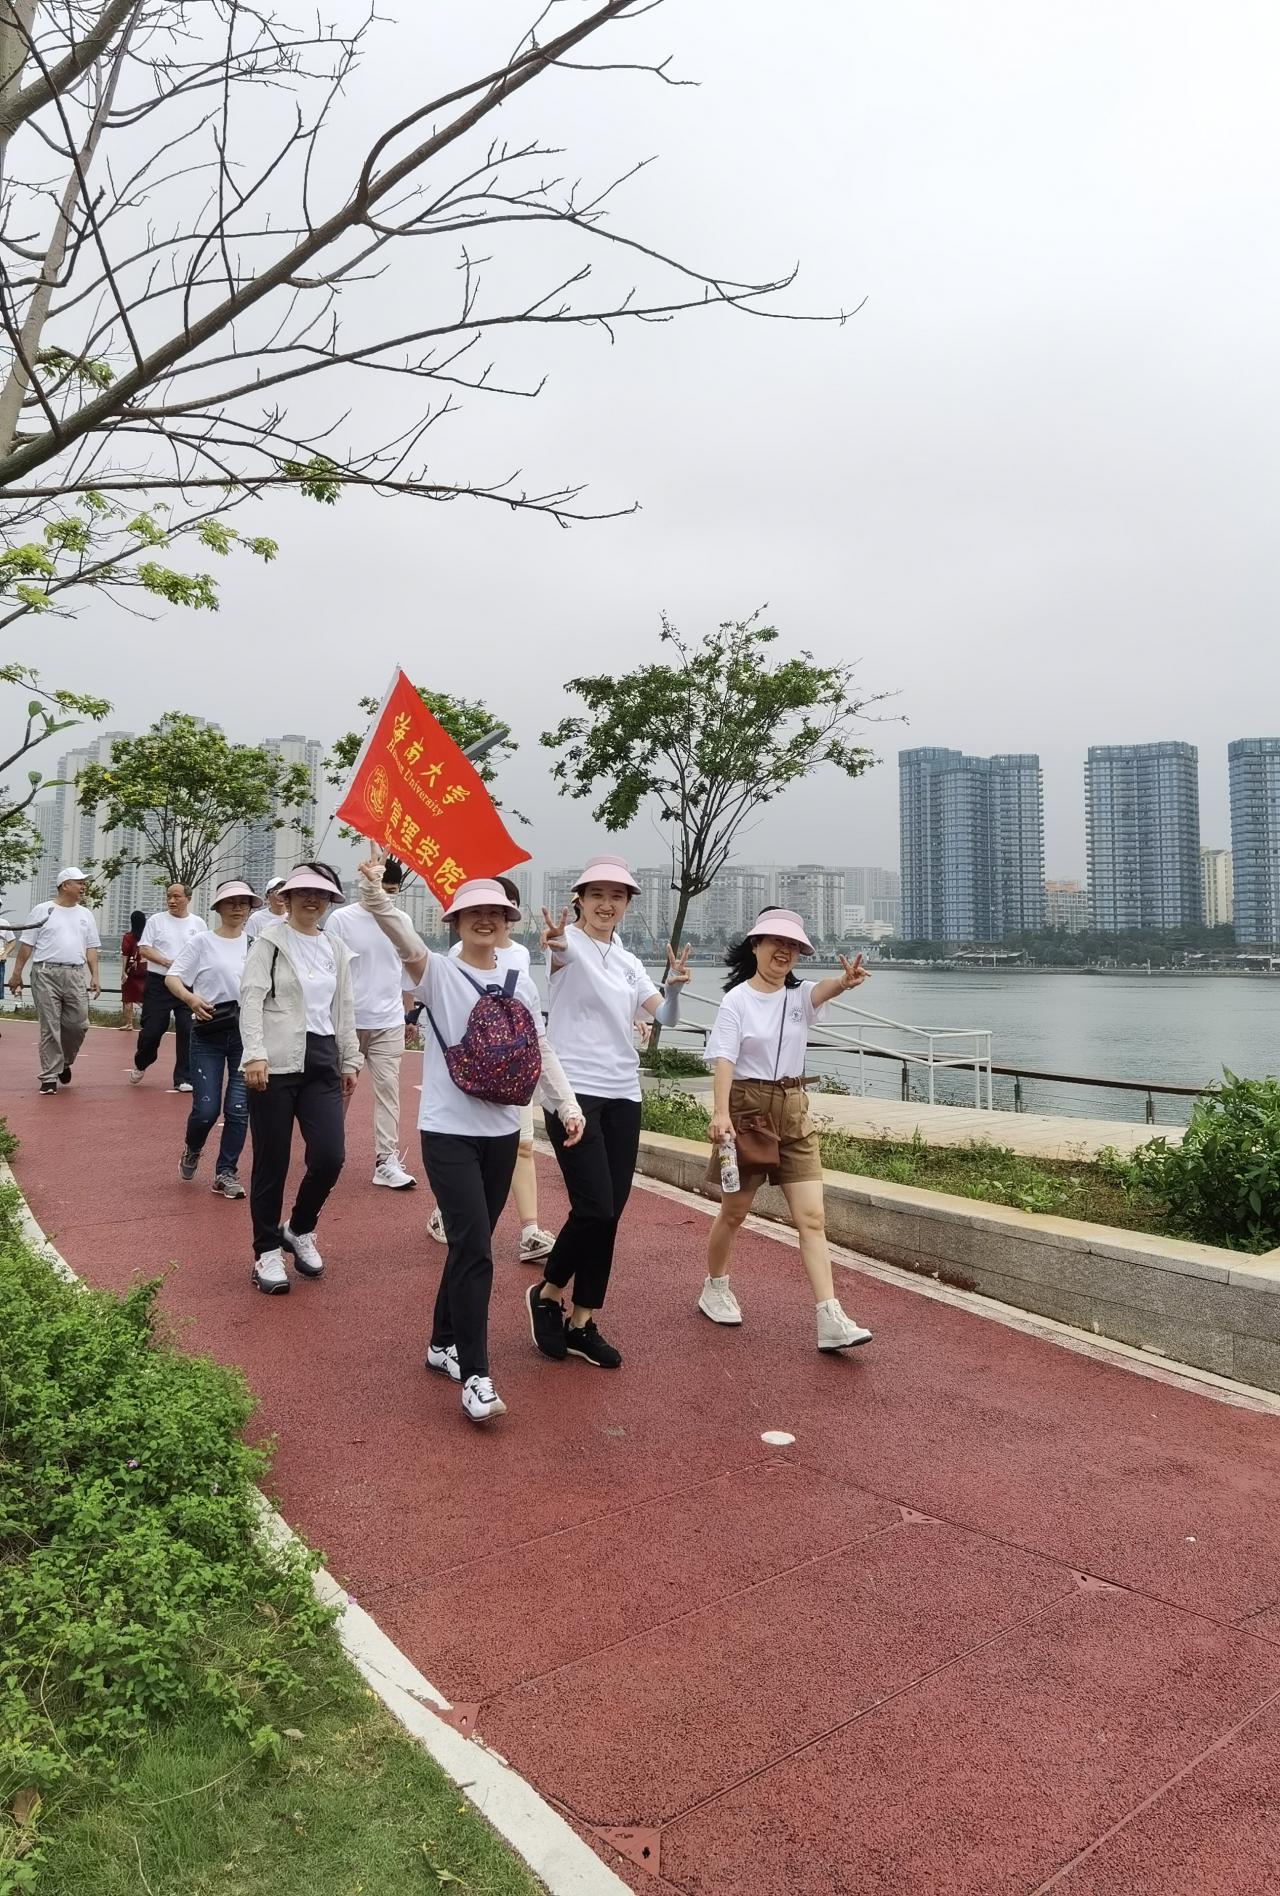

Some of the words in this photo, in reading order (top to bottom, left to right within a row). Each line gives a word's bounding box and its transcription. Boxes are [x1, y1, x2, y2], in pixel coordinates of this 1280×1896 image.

[386, 738, 405, 775] Han
[403, 768, 444, 817] University
[390, 797, 467, 895] 管理学院
